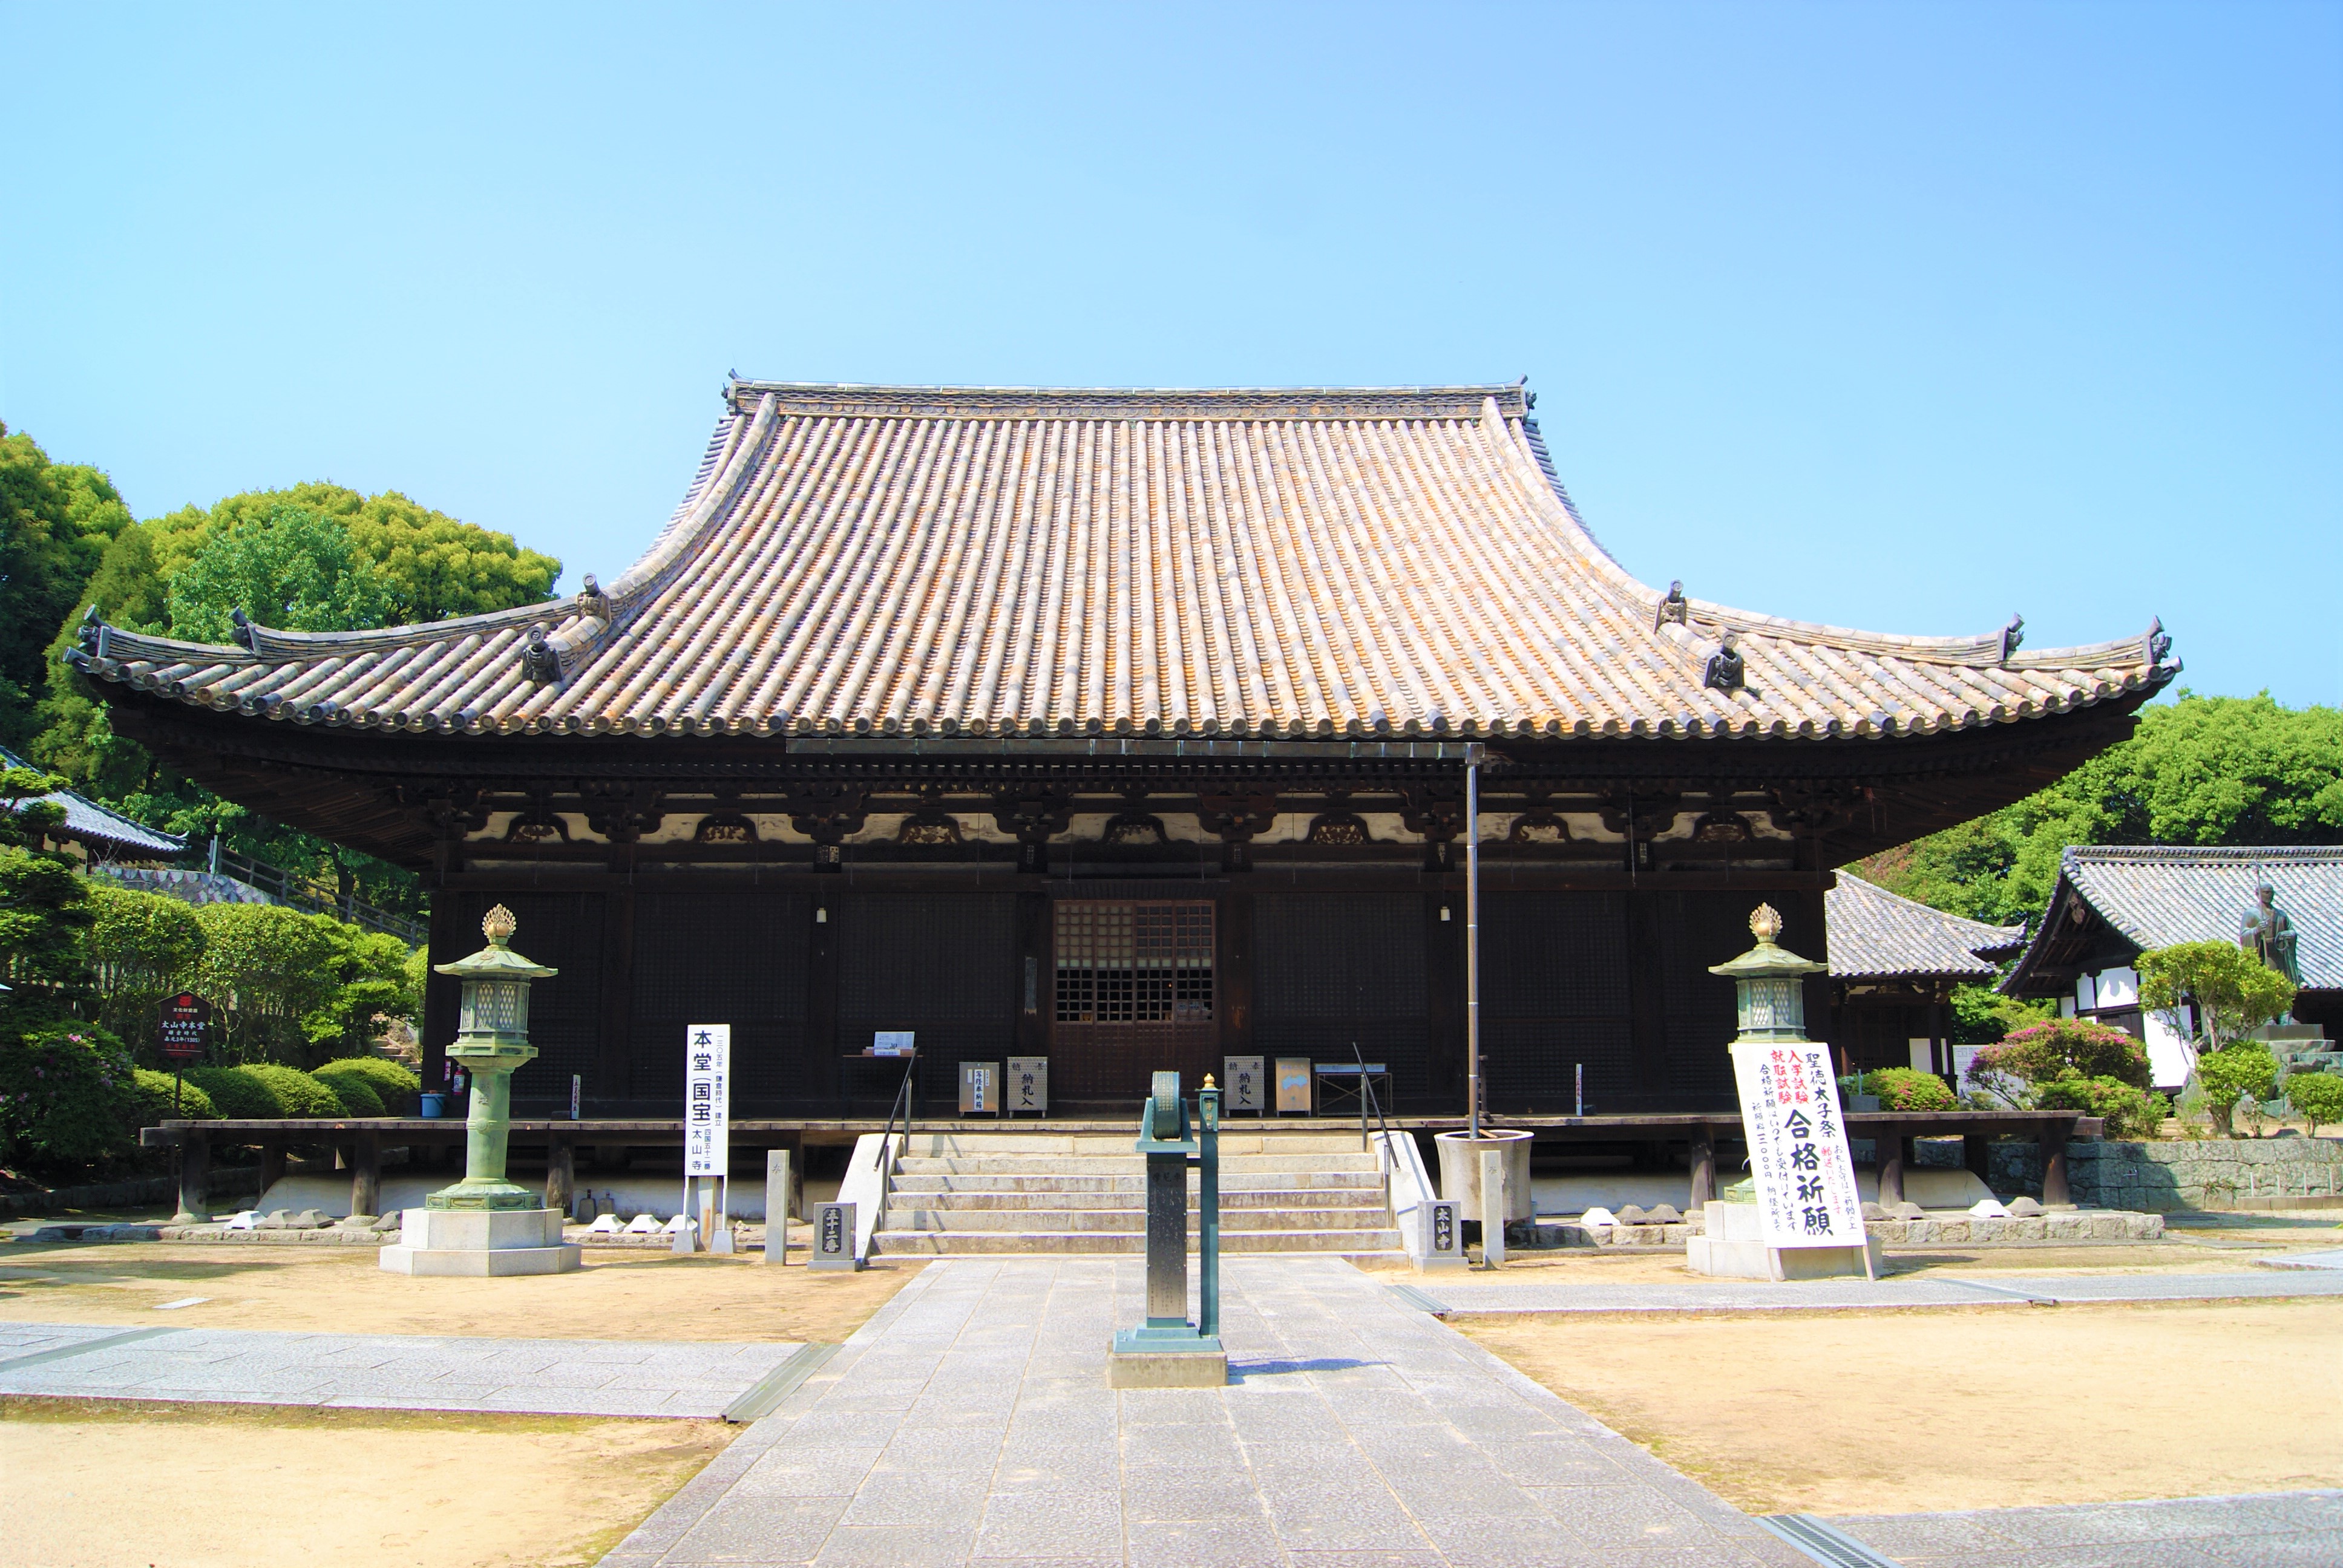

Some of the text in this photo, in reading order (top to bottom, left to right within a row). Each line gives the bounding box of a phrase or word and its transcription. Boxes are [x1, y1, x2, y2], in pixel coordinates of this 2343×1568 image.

[161, 1021, 206, 1030] 太山寺本堂
[1021, 1074, 1034, 1106] 納札入
[1239, 1073, 1251, 1105] 納札入
[1788, 1050, 1809, 1105] 入学試験
[1806, 1053, 1837, 1138] 聖徳太子祭
[692, 1129, 702, 1171] 太山寺
[1784, 1109, 1833, 1236] 合格祈願
[825, 1209, 839, 1252] 五十二番
[1437, 1207, 1450, 1250] 太山寺
